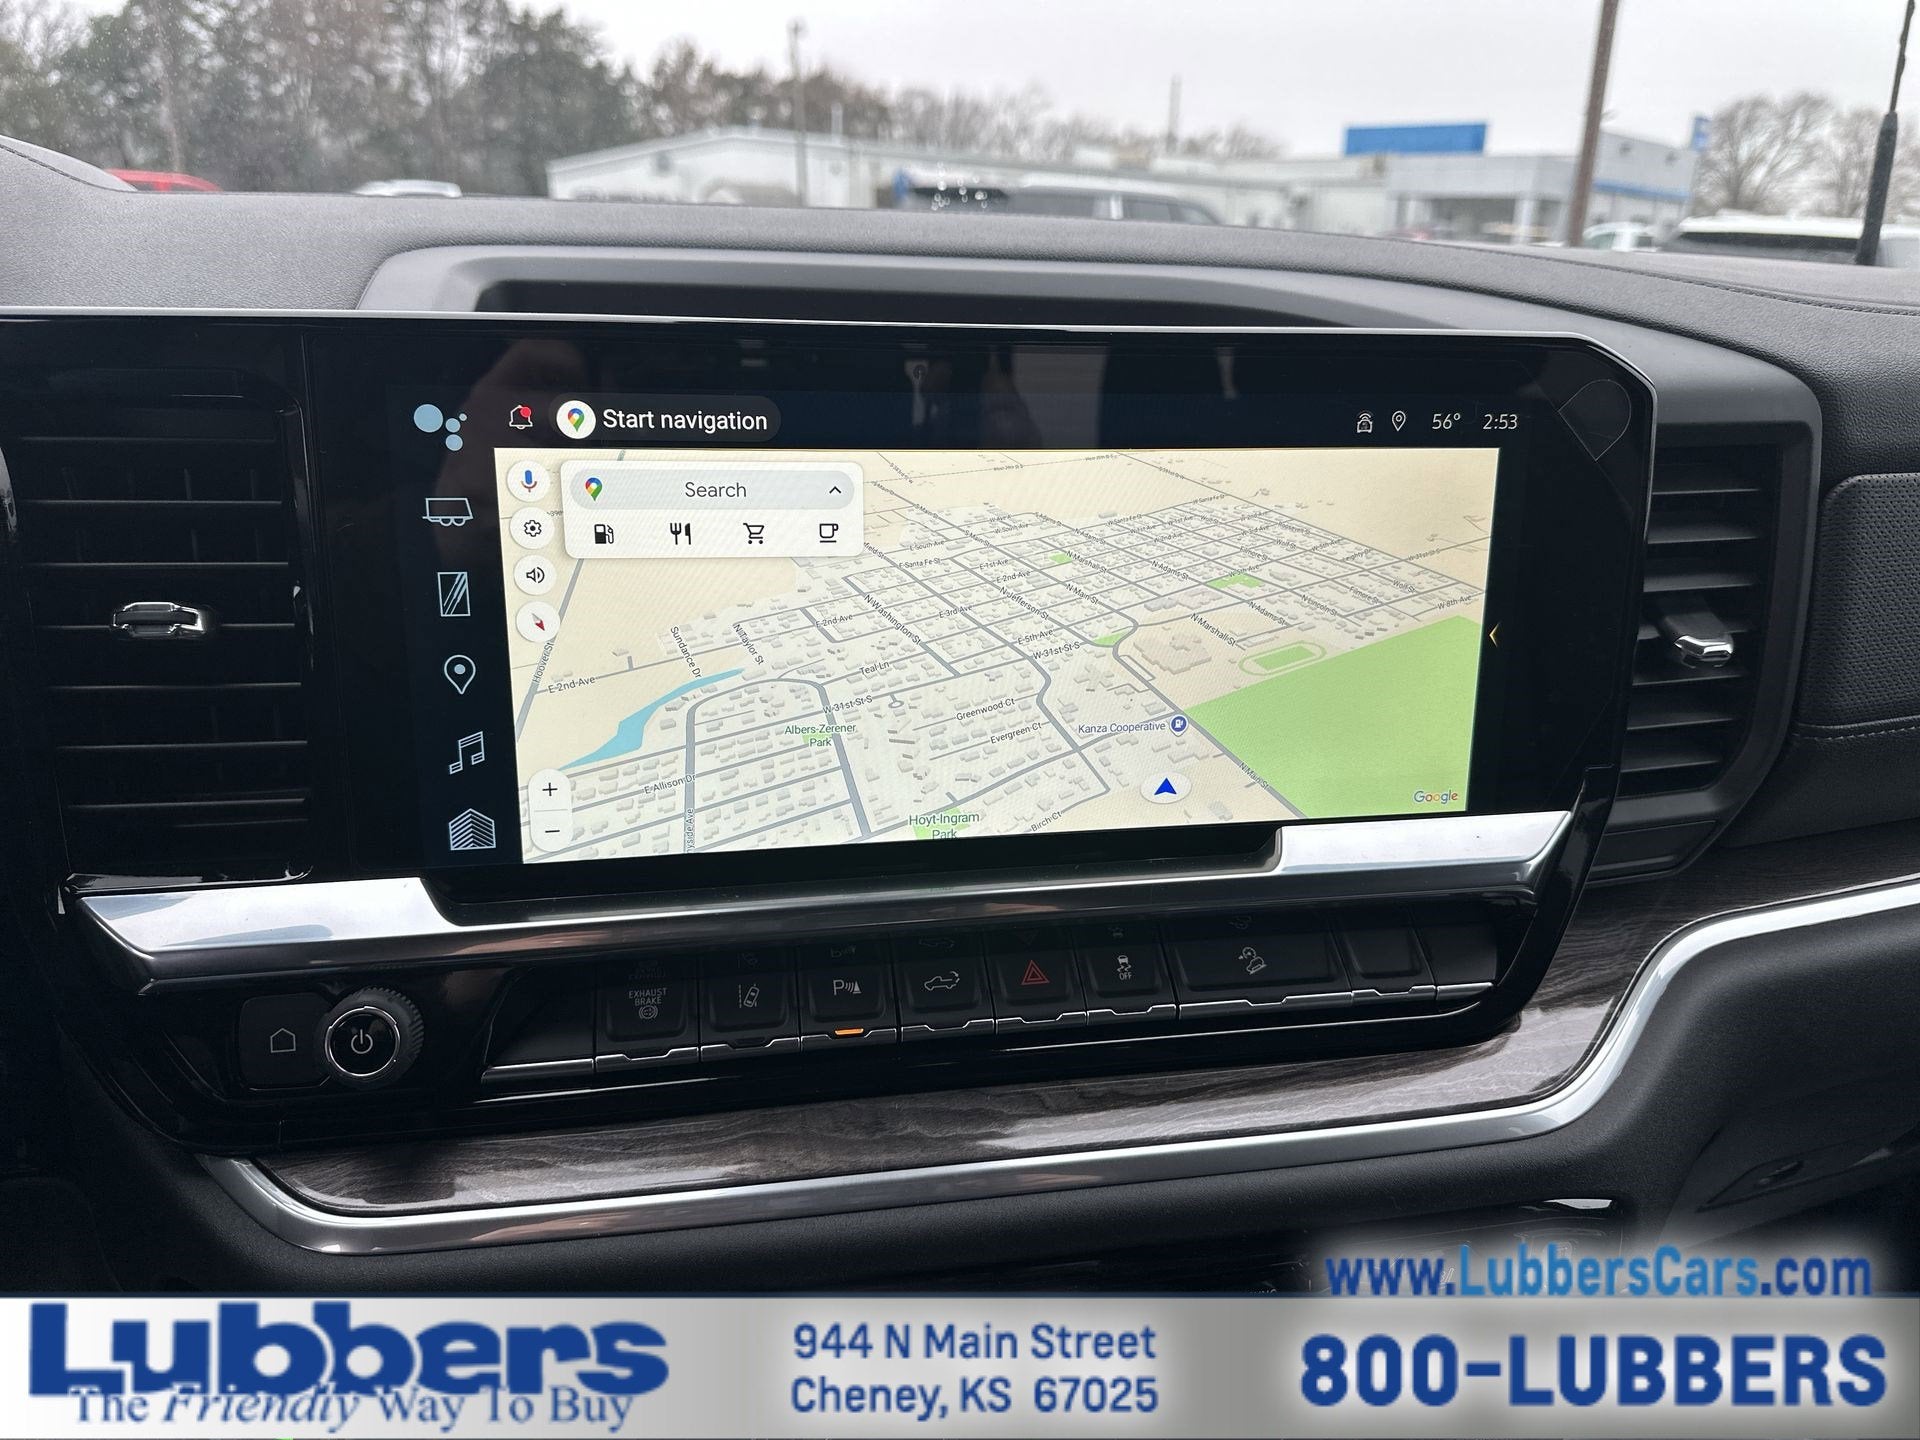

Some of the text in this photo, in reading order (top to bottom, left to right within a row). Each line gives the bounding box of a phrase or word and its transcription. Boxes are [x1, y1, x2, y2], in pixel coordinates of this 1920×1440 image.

[603, 409, 767, 437] Start navigation
[1432, 412, 1461, 430] 56°
[1483, 413, 1518, 430] 2:53
[684, 481, 747, 499] Search
[904, 560, 924, 568] Santa
[1067, 550, 1107, 573] N Marshall St
[1152, 560, 1189, 580] N Adams St
[1002, 573, 1016, 582] 2nd
[1018, 570, 1031, 578] Ave
[1000, 586, 1049, 619] N Jefferson St
[1066, 583, 1099, 605] N Main St
[1437, 595, 1472, 611] W 8th Ave
[939, 604, 973, 618] E 3rd Ave
[1249, 601, 1286, 626] N Adams St
[1301, 594, 1308, 602] N
[1329, 608, 1338, 617] St
[815, 613, 853, 628] E 2nd Ave
[864, 594, 922, 645] N Washington St
[1018, 629, 1054, 645] E 5th Ave
[1190, 613, 1237, 647] N Marshall St
[670, 626, 701, 678] Sundance Dr
[733, 623, 764, 666] N Taylor St
[1033, 641, 1081, 661] W 31st St S
[534, 641, 555, 684] Hoover St
[859, 660, 890, 676] Teal Ln
[548, 676, 596, 694] E 2nd Ave
[822, 695, 873, 714] W 31st St S
[956, 697, 1016, 722] Greenwood Ct
[784, 722, 857, 736] Albers-Zerener
[990, 722, 1042, 746] Evergreen Ct
[1078, 722, 1167, 736] Kanza Cooperative
[809, 737, 832, 748] Park
[643, 773, 696, 795] E Allison Dr
[1238, 761, 1270, 790] N Main St
[1413, 789, 1459, 805] Google
[686, 808, 695, 825] Ave
[908, 813, 980, 826] Hoyt-Ingram
[1030, 810, 1062, 832] Birch Ct
[931, 829, 957, 840] Park
[1119, 971, 1132, 980] OFF
[628, 987, 667, 999] EXHAUST
[634, 996, 662, 1006] BRAKE
